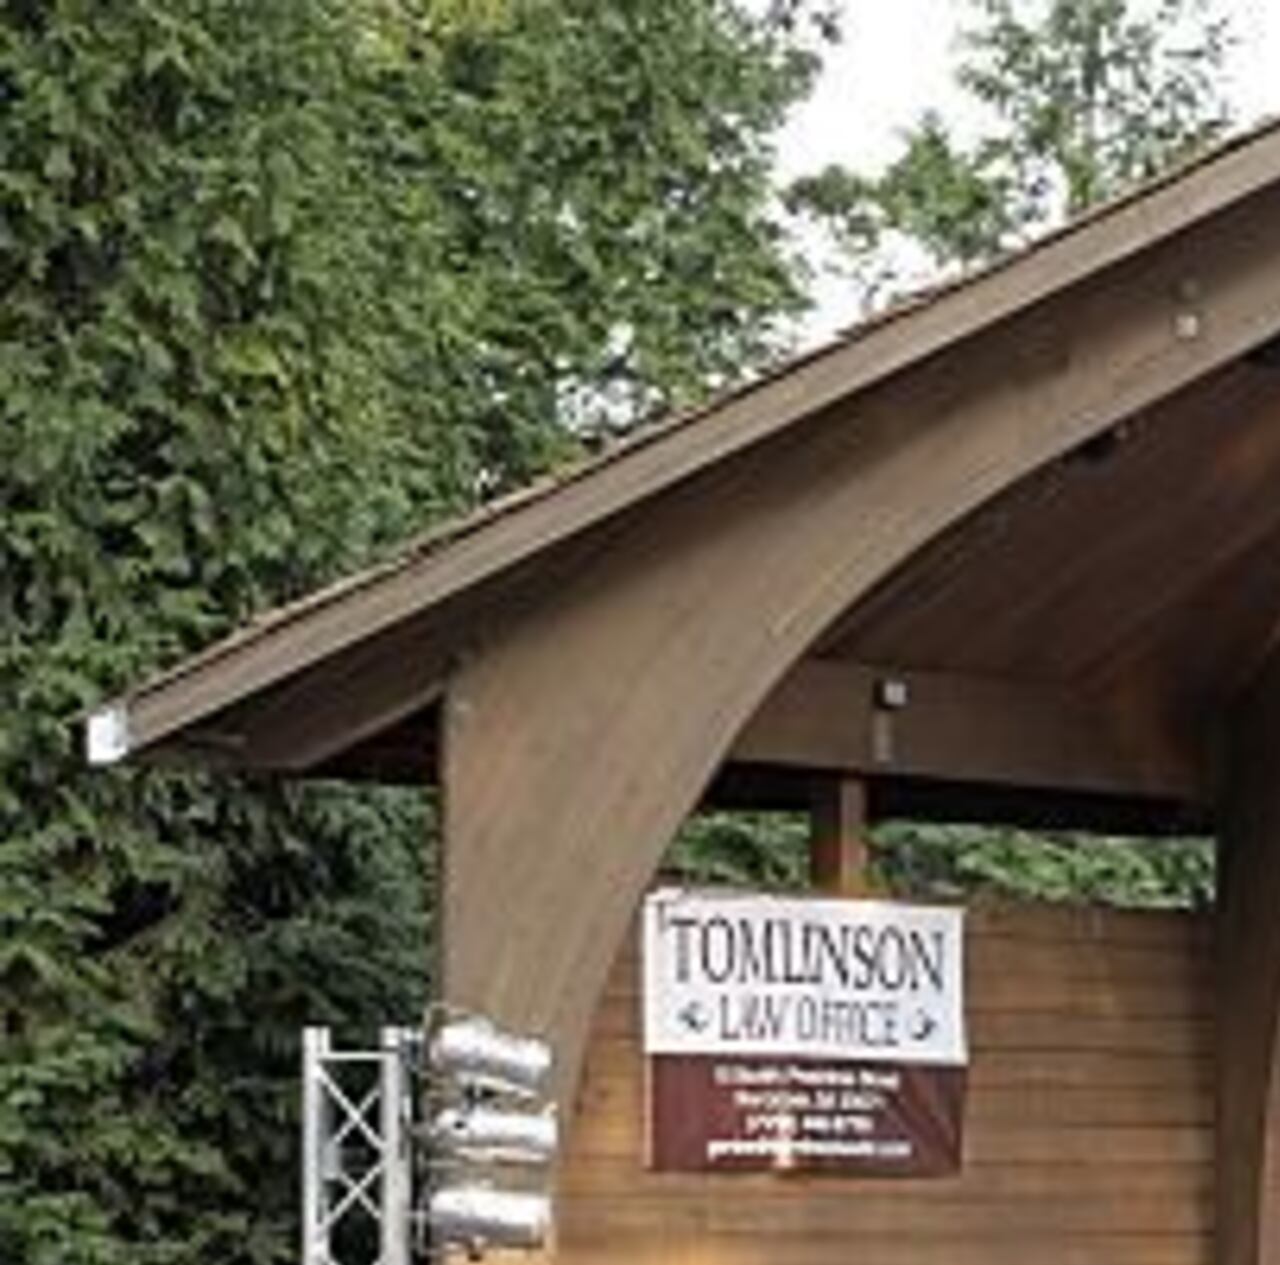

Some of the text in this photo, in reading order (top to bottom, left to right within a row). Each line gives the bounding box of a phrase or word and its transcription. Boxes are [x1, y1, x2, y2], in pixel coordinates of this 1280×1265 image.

[669, 917, 945, 991] TOMLINSON
[720, 994, 900, 1047] LAW OFFICE
